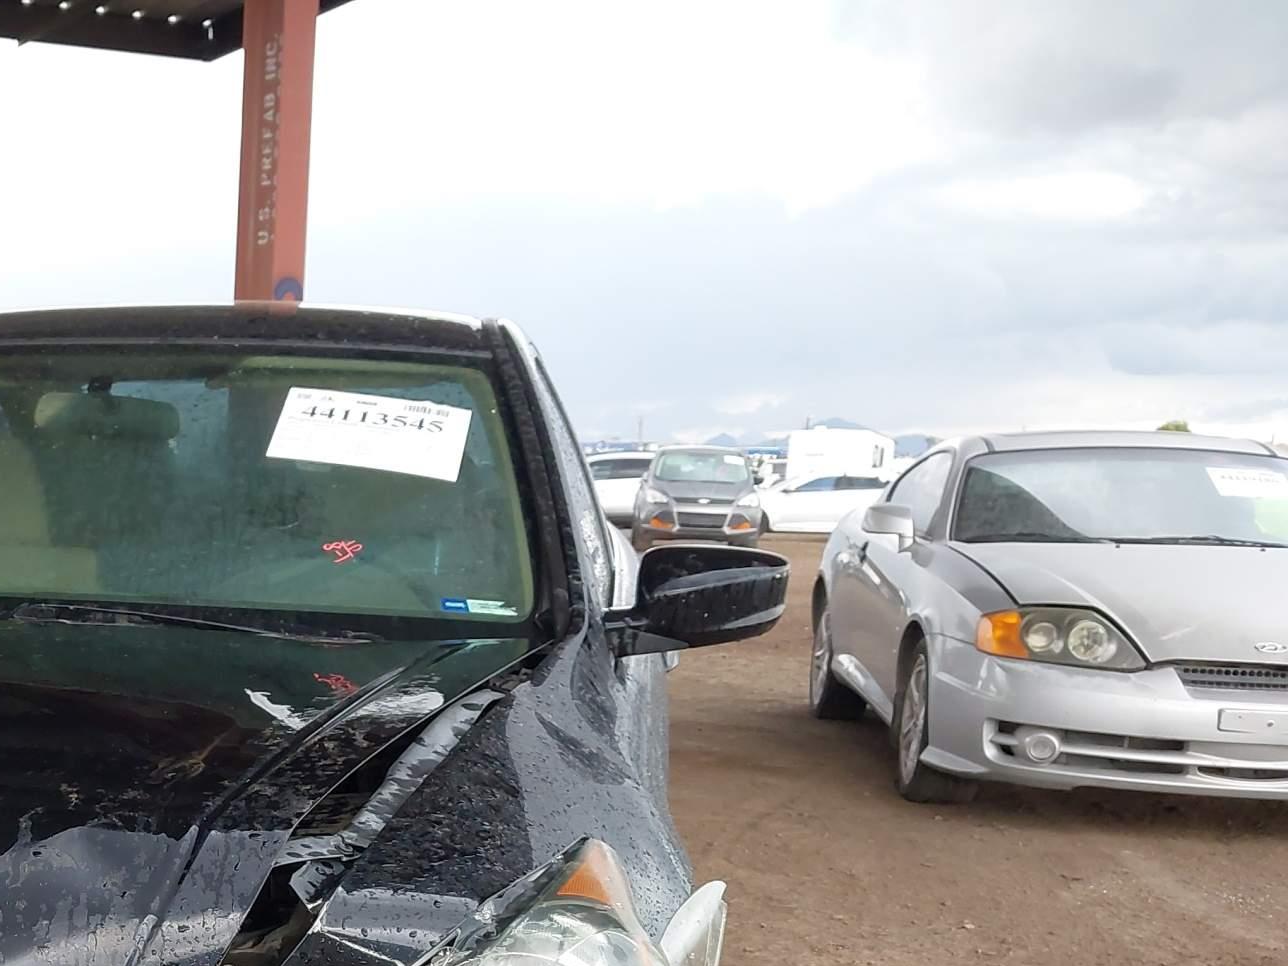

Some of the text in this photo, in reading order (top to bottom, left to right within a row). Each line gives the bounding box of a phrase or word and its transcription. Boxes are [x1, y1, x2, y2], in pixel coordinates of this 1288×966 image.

[264, 32, 279, 81] INC.
[261, 92, 276, 186] PREFAB
[300, 404, 445, 434] 44113545
